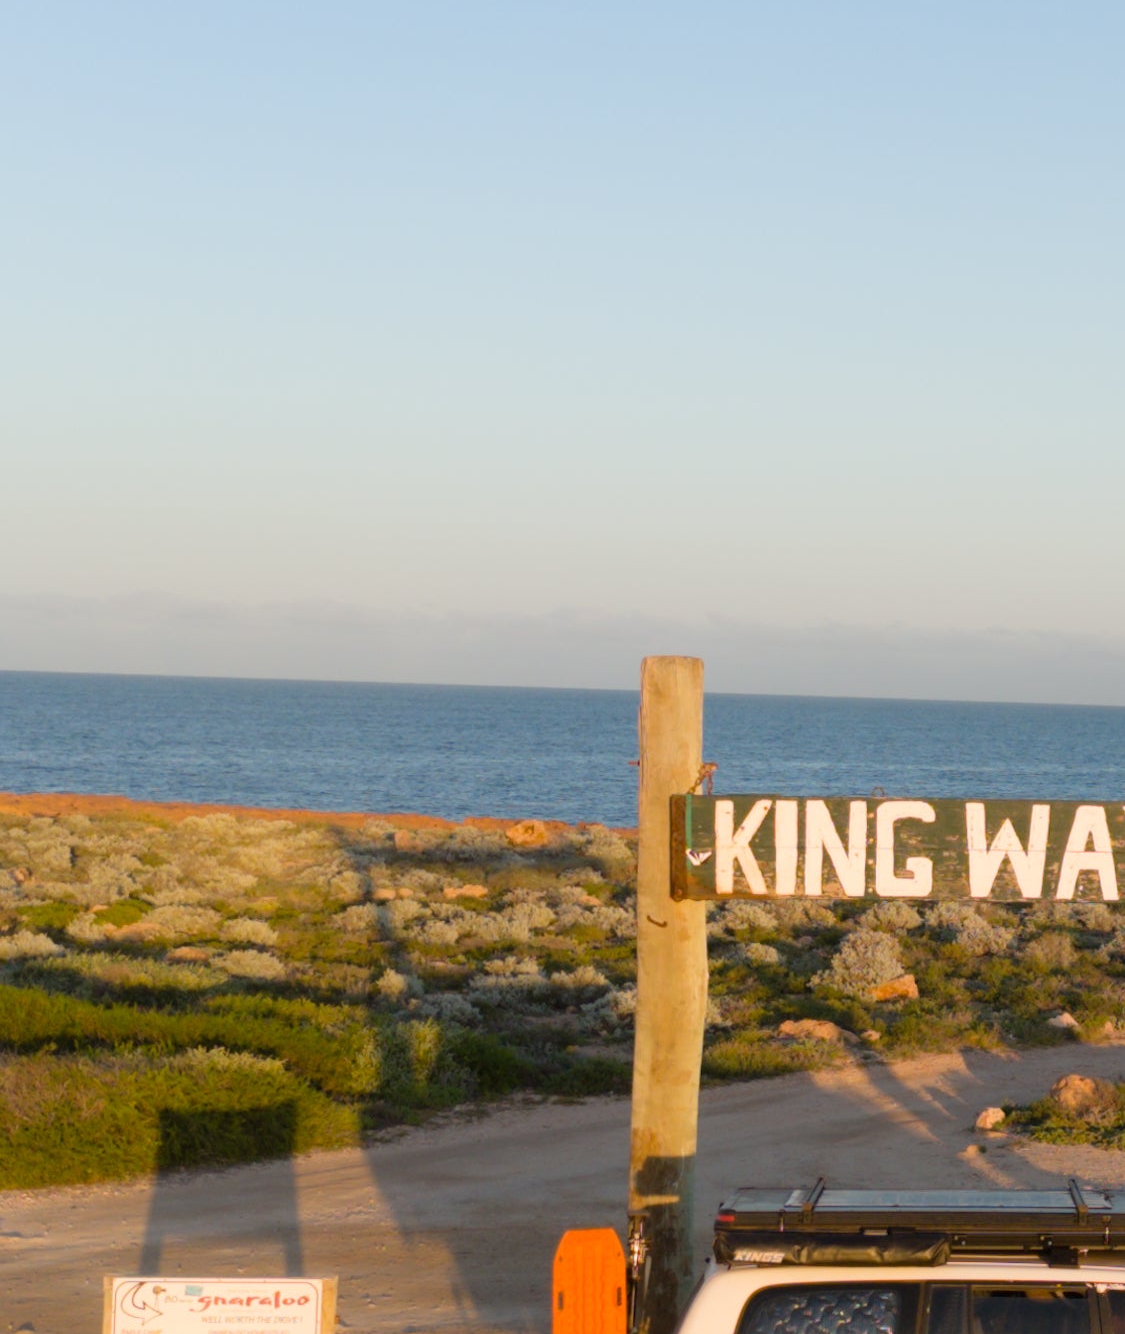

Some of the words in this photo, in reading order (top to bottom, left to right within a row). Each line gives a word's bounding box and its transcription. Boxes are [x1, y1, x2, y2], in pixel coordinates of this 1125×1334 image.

[714, 799, 934, 898] KING
[733, 1250, 786, 1264] KINGS
[188, 1290, 310, 1313] gnaraloo
